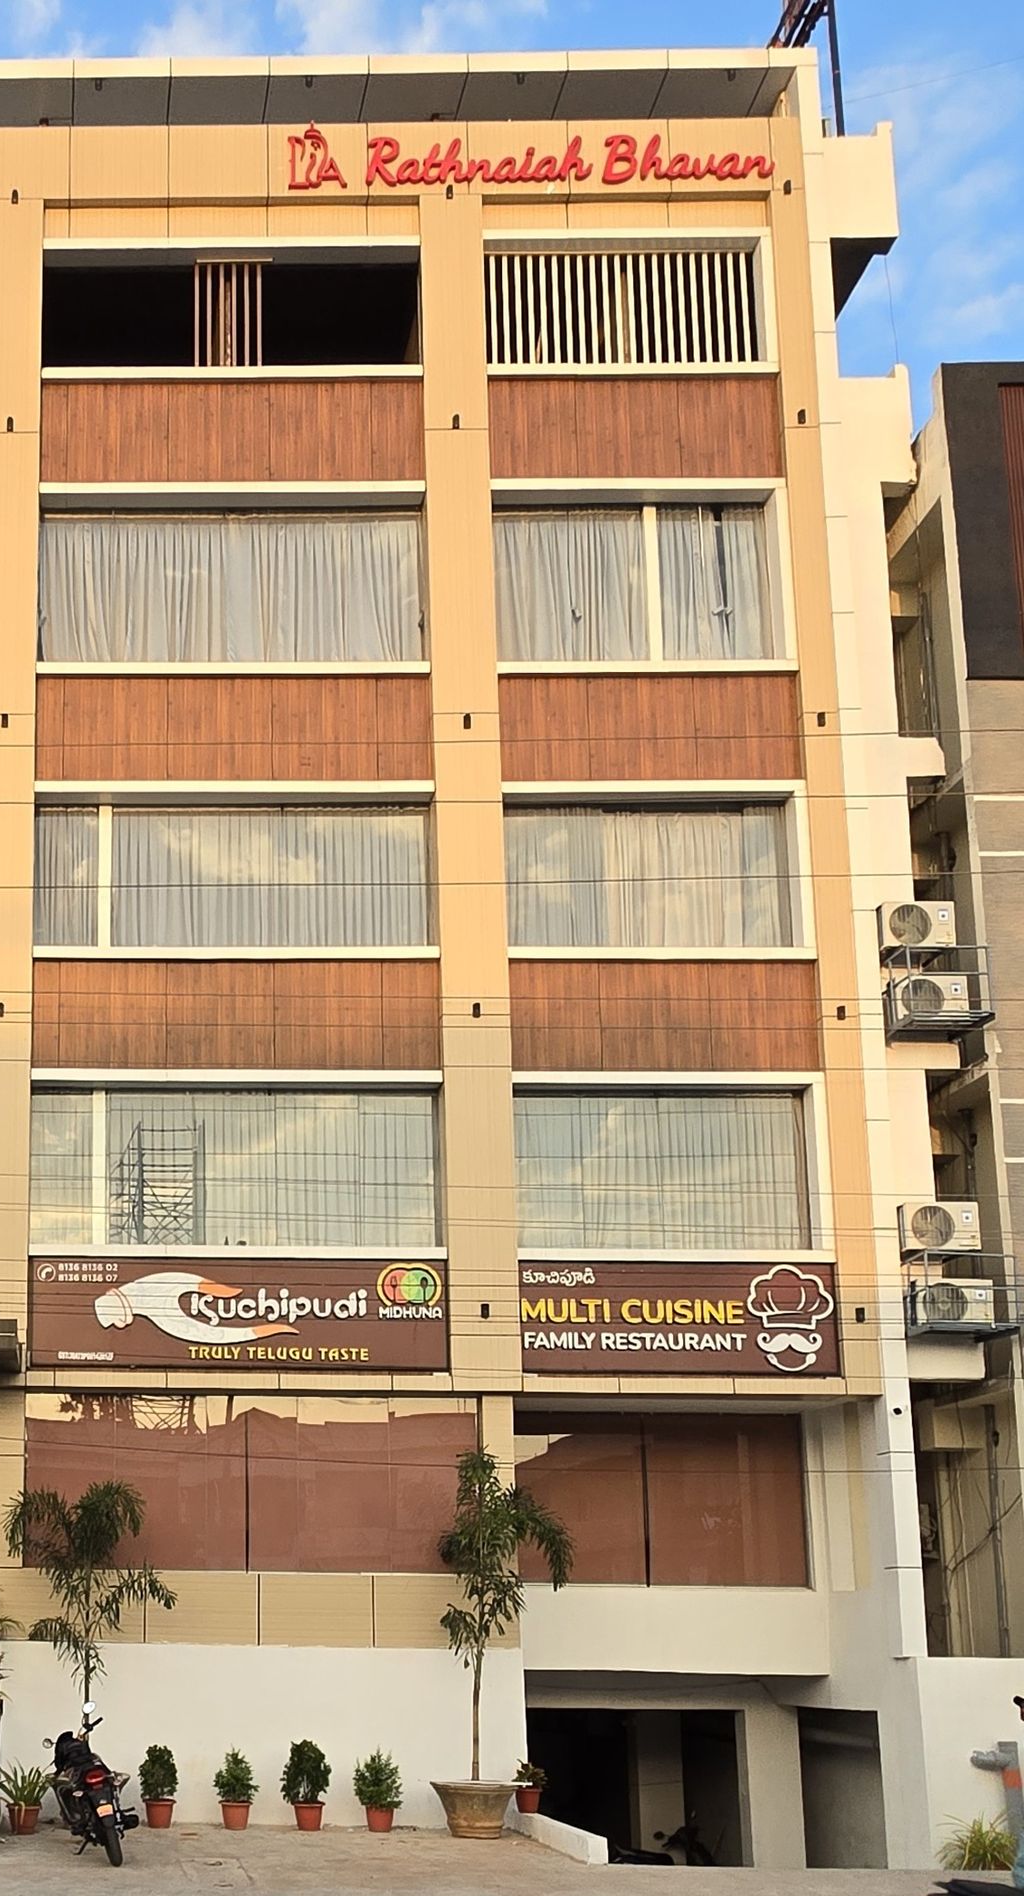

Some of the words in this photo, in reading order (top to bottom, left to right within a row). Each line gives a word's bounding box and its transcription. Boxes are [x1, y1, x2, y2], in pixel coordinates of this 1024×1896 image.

[366, 135, 593, 186] Rathnaiah
[602, 133, 775, 185] Bhavan
[105, 1263, 118, 1271] 02
[105, 1274, 118, 1282] 07
[190, 1287, 368, 1326] Kuchipudi
[378, 1305, 443, 1319] MIDHUNA
[521, 1298, 611, 1324] MULTI
[621, 1299, 745, 1325] CUISINE
[524, 1332, 596, 1350] FAMILY
[601, 1332, 747, 1351] RESTAURANT
[188, 1346, 241, 1361] TRULY
[247, 1346, 313, 1361] TELUGU
[319, 1347, 369, 1361] TASTE
